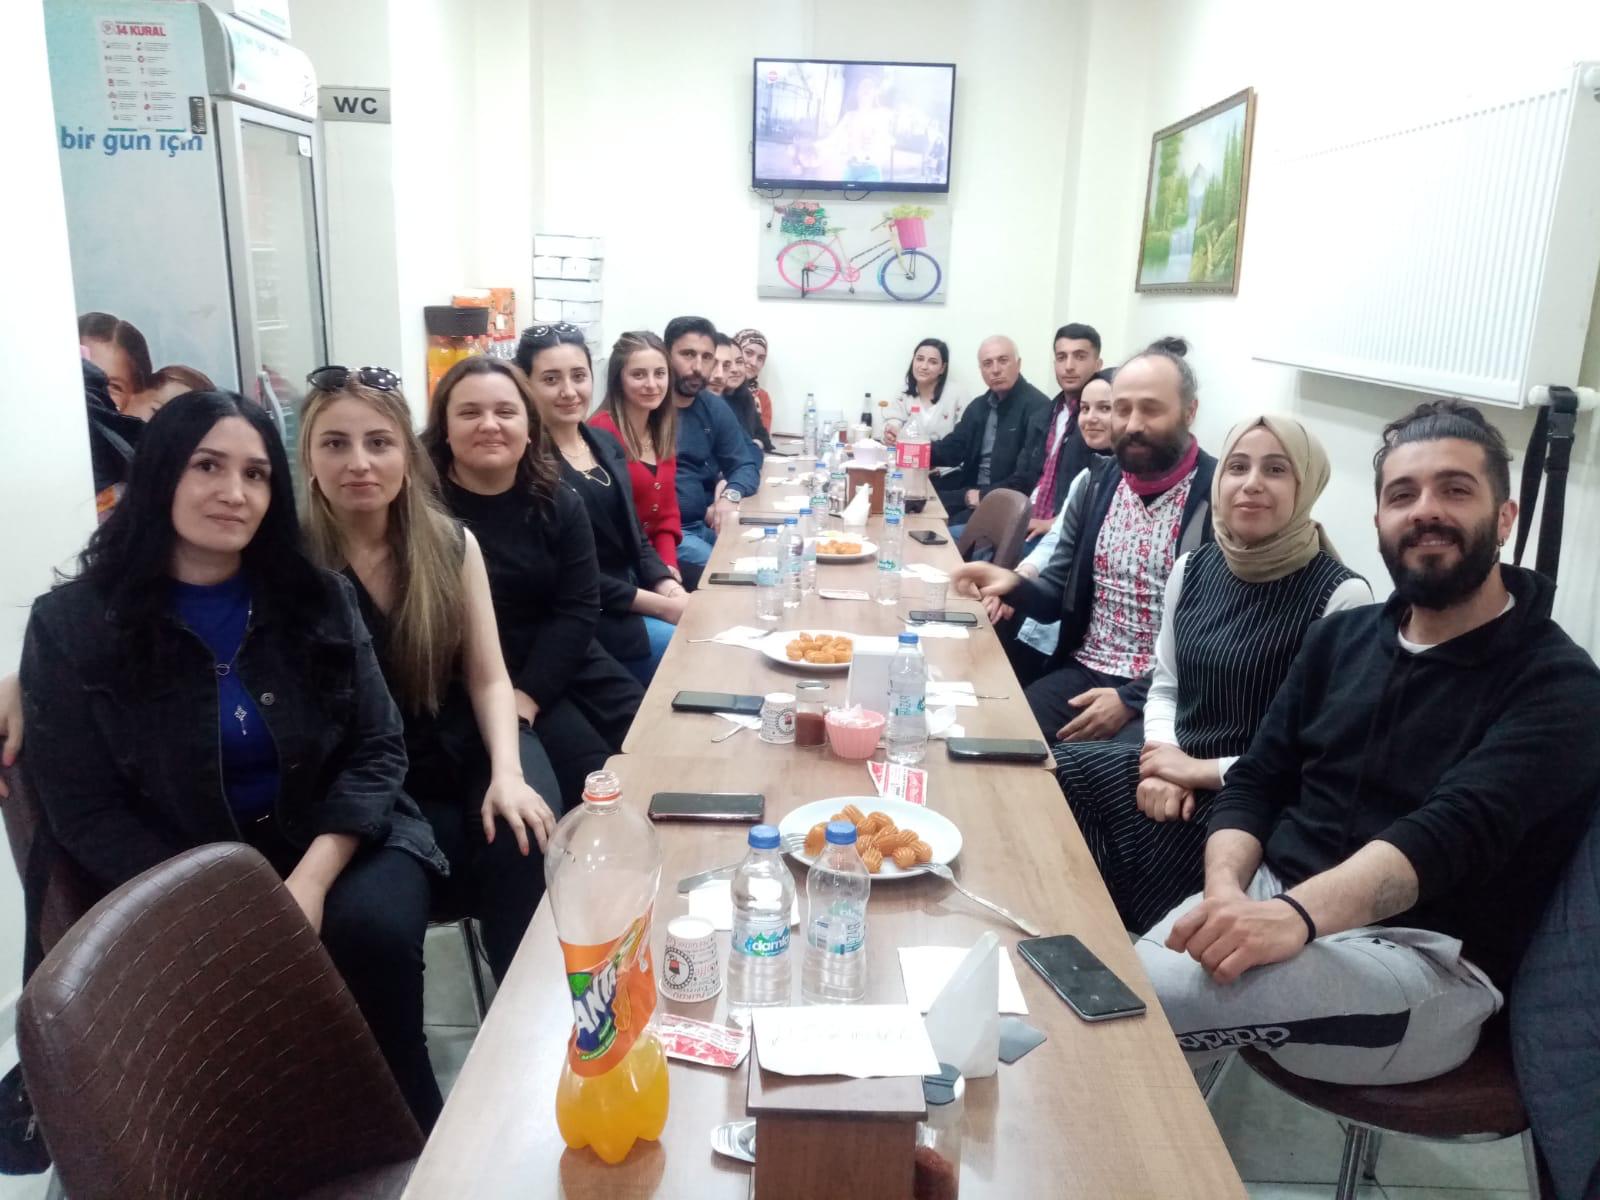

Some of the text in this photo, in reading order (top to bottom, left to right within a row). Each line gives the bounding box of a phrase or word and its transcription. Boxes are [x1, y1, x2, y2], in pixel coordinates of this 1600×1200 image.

[116, 25, 167, 37] 14 KURAL
[333, 96, 378, 115] WC
[60, 125, 95, 150] bir
